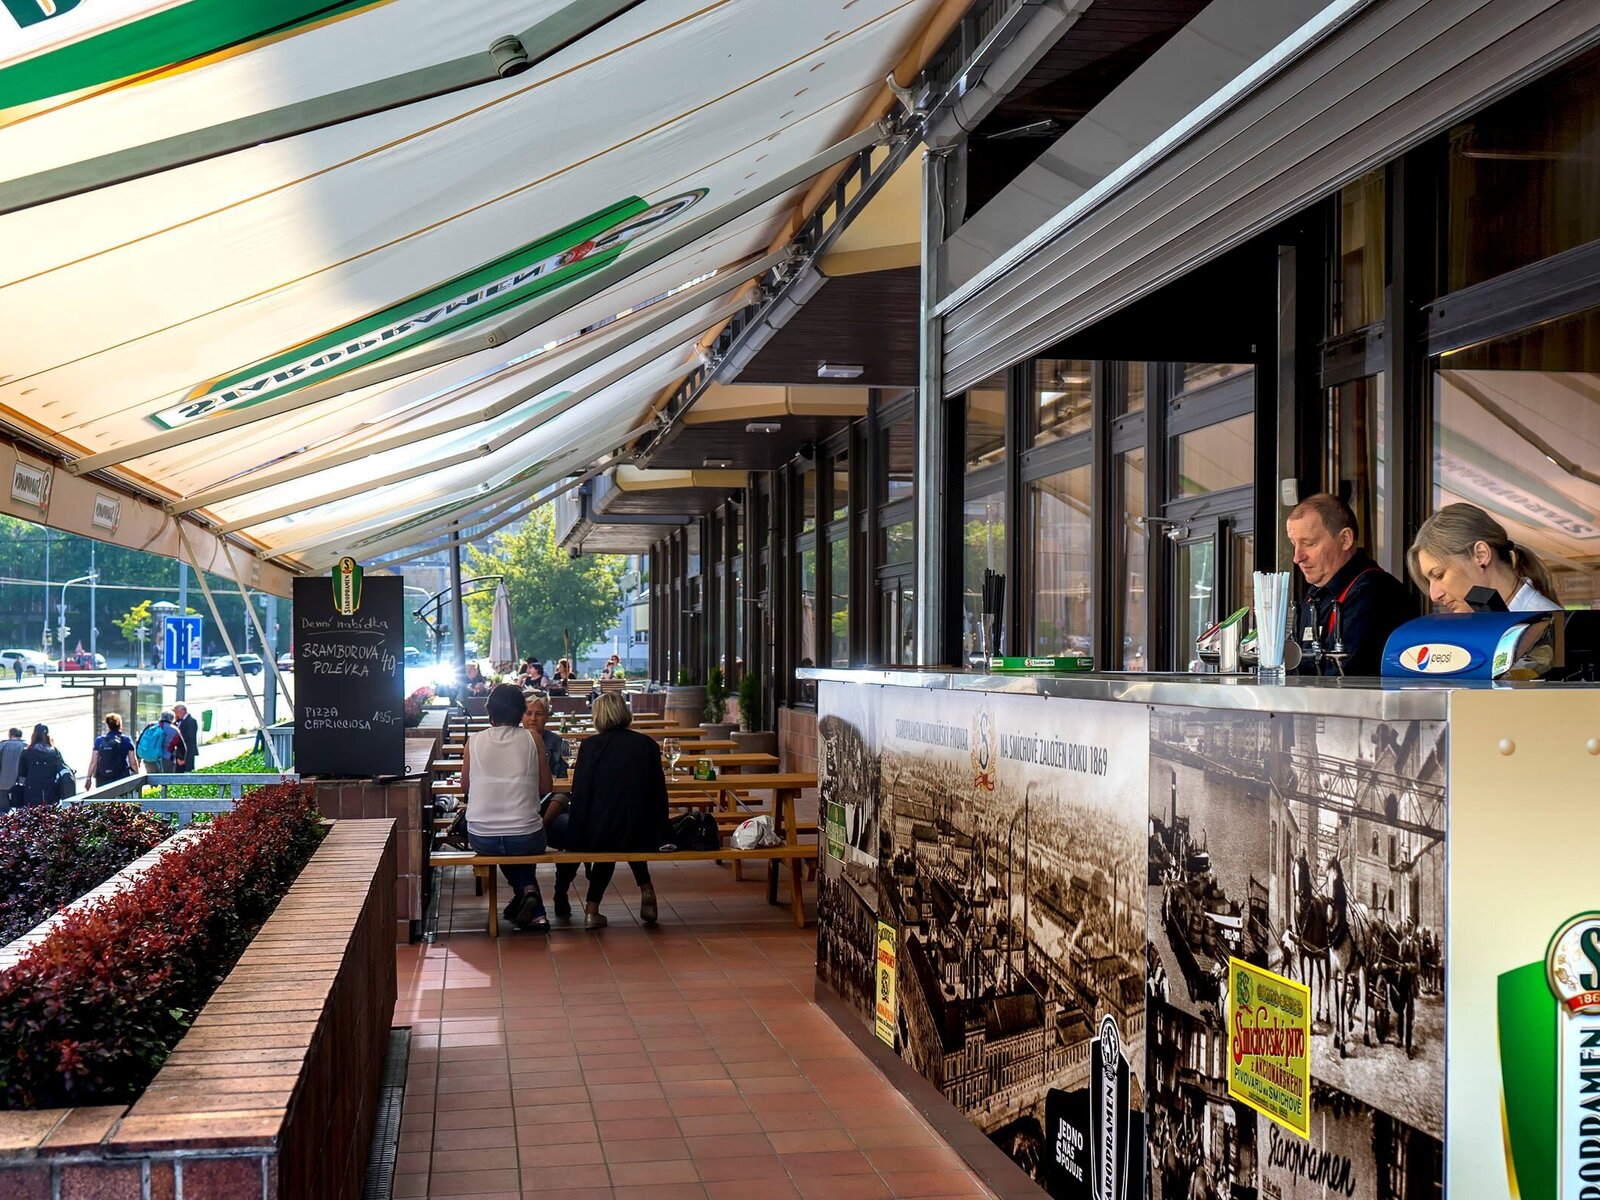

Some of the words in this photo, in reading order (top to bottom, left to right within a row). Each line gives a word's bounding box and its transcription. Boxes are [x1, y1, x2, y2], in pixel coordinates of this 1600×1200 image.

[343, 575, 351, 614] STAROPRAMEN
[302, 616, 333, 629] Denní
[337, 616, 389, 629] nabídka
[302, 639, 386, 660] BRAMBOROVÁ
[1431, 652, 1452, 664] pepsi
[313, 659, 369, 677] POLÉVKA
[305, 706, 338, 718] PIZZA
[304, 719, 371, 730] CAPRICCIOSA
[1000, 734, 1008, 759] NA
[1009, 730, 1038, 763] SMÍCHOVĚ
[1039, 734, 1067, 769] ZALOŽEN
[1068, 743, 1087, 773] ROKU
[1090, 746, 1108, 776] 1869
[1233, 1005, 1285, 1065] Smíchovské
[1285, 1021, 1304, 1067] pivo
[1234, 1067, 1263, 1093] PIVOVARU
[1057, 1117, 1084, 1151] JEDNO
[1062, 1140, 1075, 1159] NÁS
[1268, 1122, 1356, 1198] Staropramen
[1056, 1143, 1084, 1183] SPOJUJE
